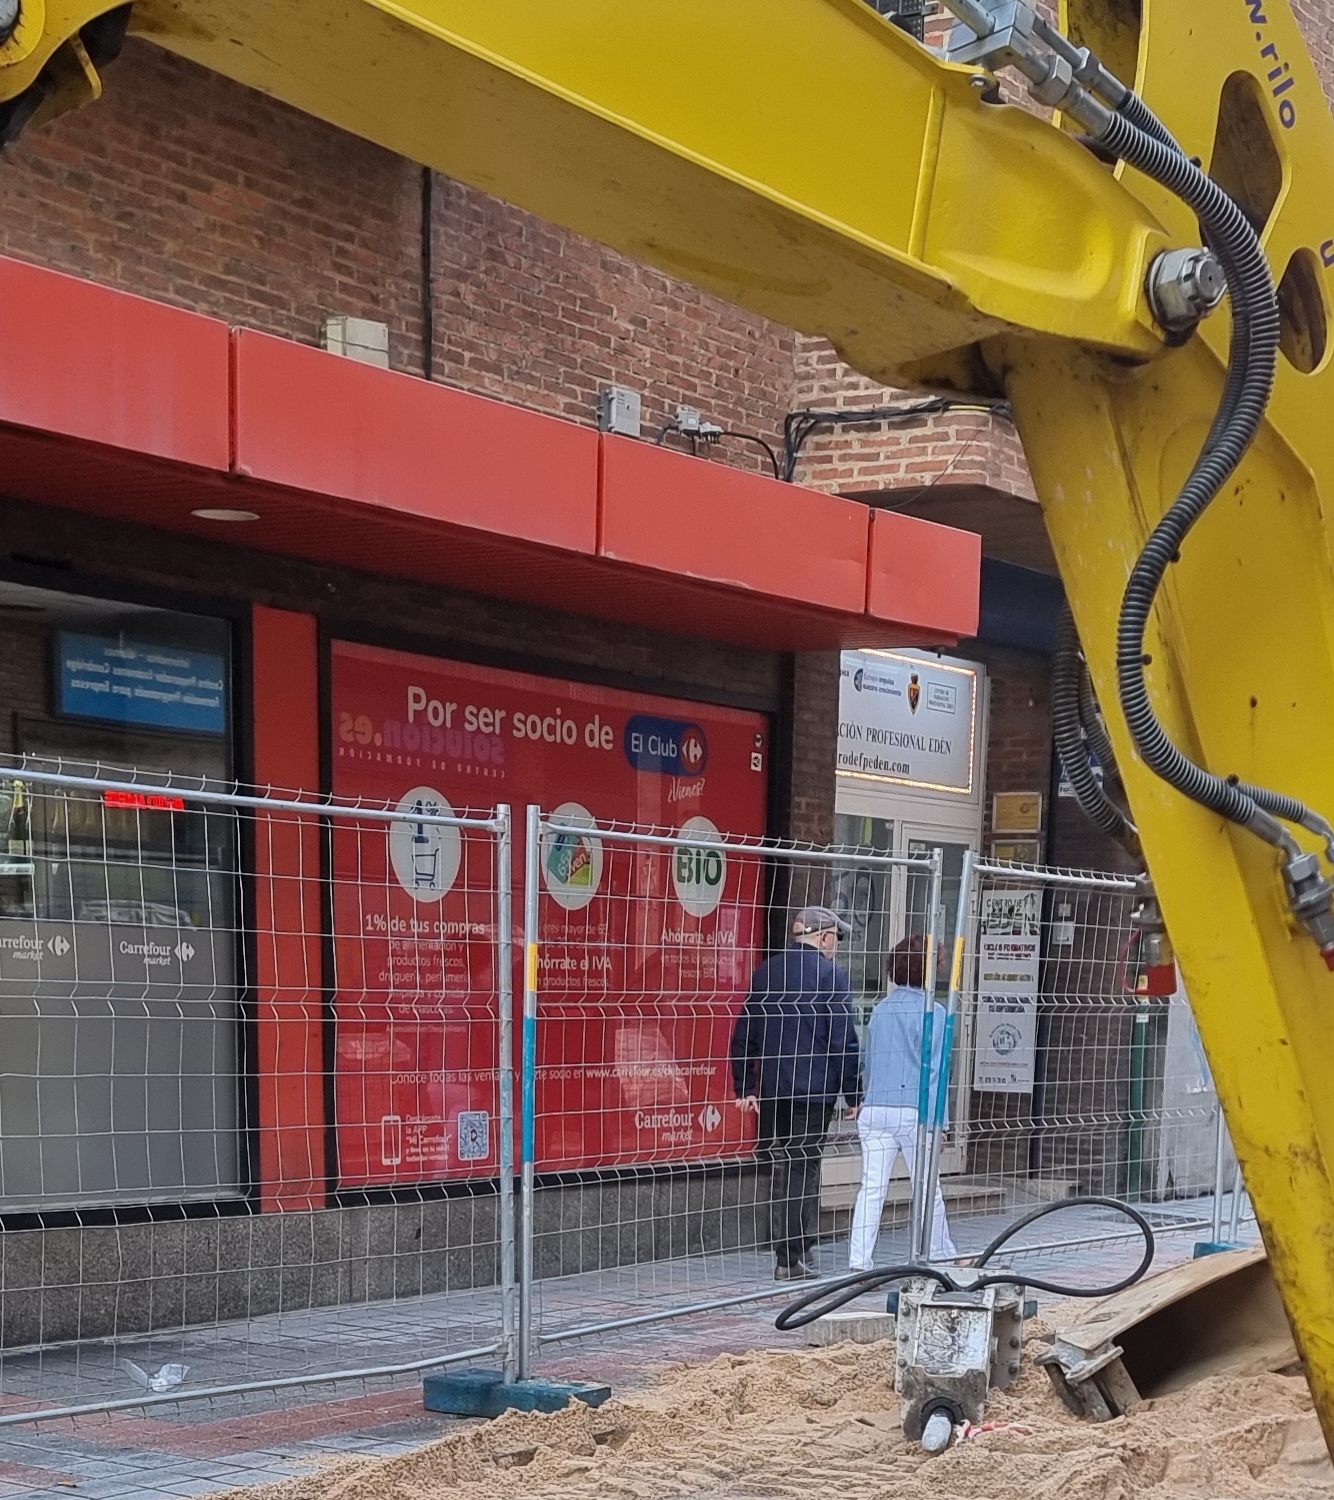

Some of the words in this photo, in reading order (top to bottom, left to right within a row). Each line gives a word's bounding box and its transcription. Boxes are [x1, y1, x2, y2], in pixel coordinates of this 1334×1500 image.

[407, 686, 457, 728] Por
[464, 704, 506, 735] ser
[512, 708, 578, 746] socio
[584, 714, 615, 751] de
[631, 732, 643, 753] El
[648, 735, 678, 758] Club
[838, 721, 863, 740] CIÓN
[866, 726, 926, 752] PROFESIONAL
[929, 737, 953, 755] EDÉN
[838, 751, 911, 775] rodefpeden.com
[676, 848, 723, 886] BIO
[365, 914, 387, 932] 1%
[391, 916, 407, 932] de
[409, 918, 430, 933] tus
[433, 921, 486, 936] compras
[661, 927, 705, 945] Ahórrate
[718, 930, 736, 945] IVA
[119, 940, 172, 957] Carrefour
[537, 953, 577, 970] hórrate
[592, 955, 613, 971] IVA
[475, 1070, 500, 1082] venta
[635, 1108, 695, 1129] Carrefour
[662, 1128, 694, 1142] market
